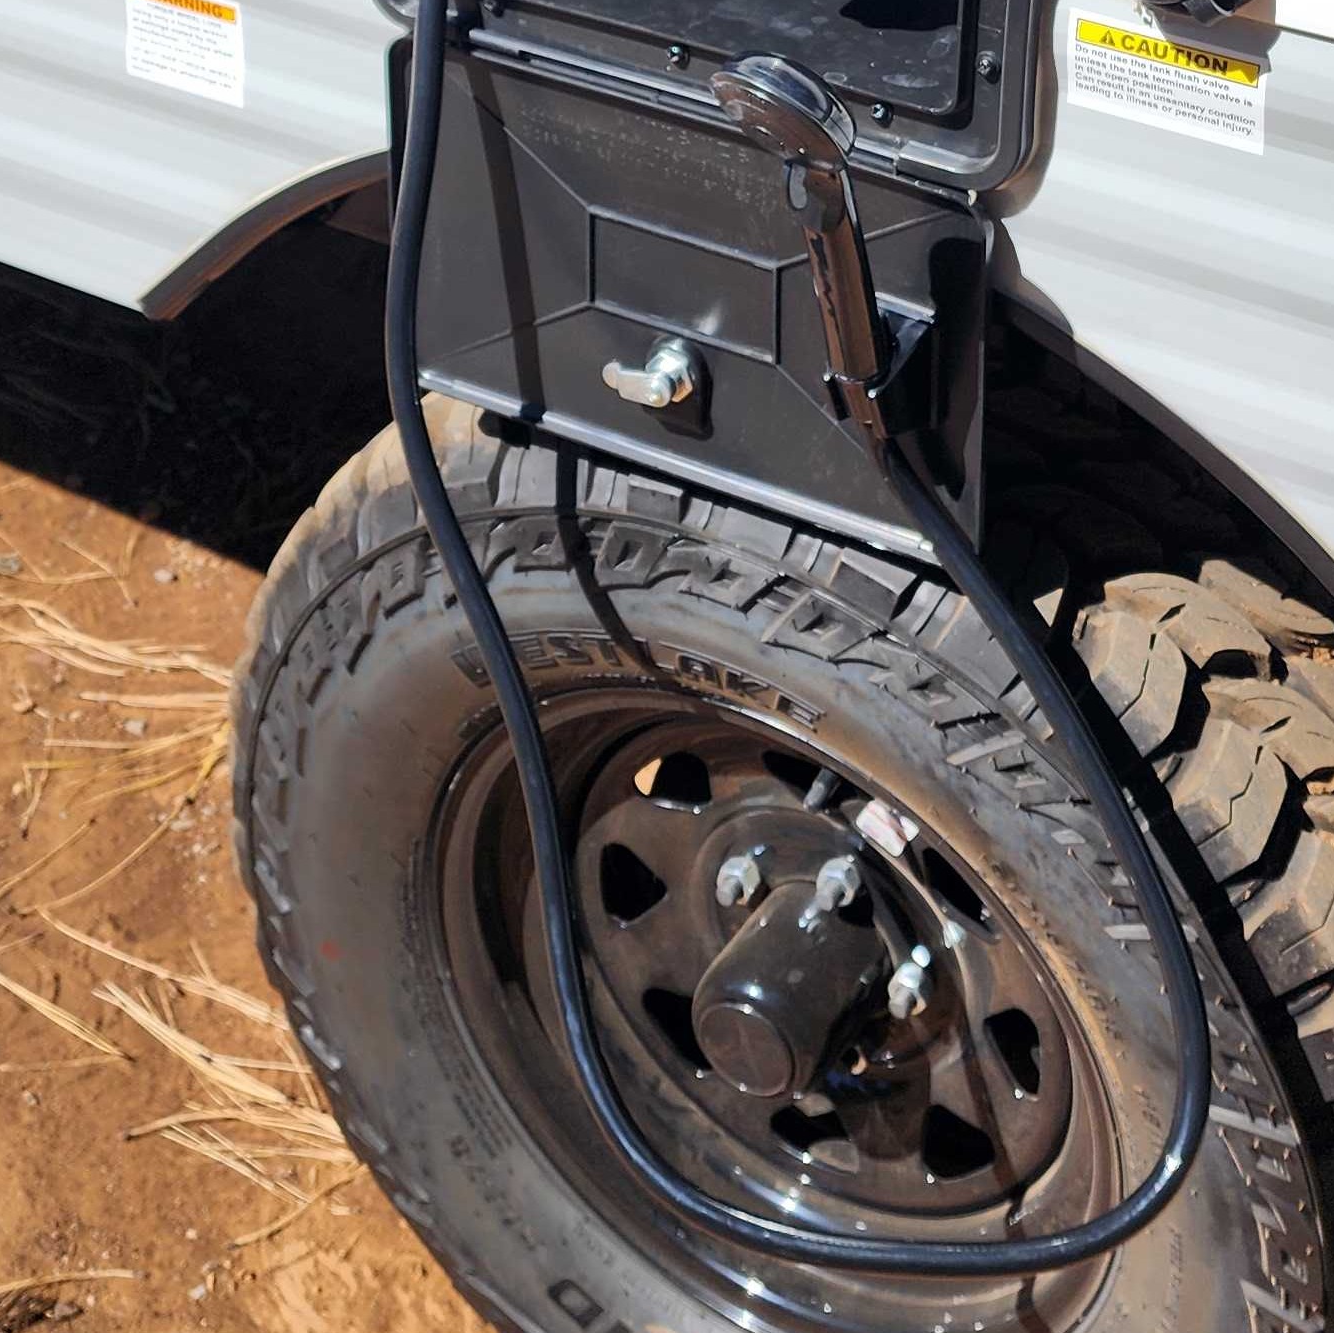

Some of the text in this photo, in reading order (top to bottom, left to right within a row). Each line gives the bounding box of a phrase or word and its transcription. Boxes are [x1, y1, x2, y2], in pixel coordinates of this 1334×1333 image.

[1075, 43, 1230, 91] Do not use the tank flush valve
[1086, 66, 1102, 77] the
[1105, 72, 1130, 86] open
[1120, 34, 1229, 78] CAUTION
[1075, 56, 1253, 108] unless the tank termination valve is
[1075, 71, 1256, 127] Can result in an unsanitary condition
[1075, 80, 1111, 99] leading
[1113, 91, 1124, 100] to
[1126, 94, 1159, 110] illness
[1161, 105, 1173, 114] or
[1175, 109, 1220, 127] personal
